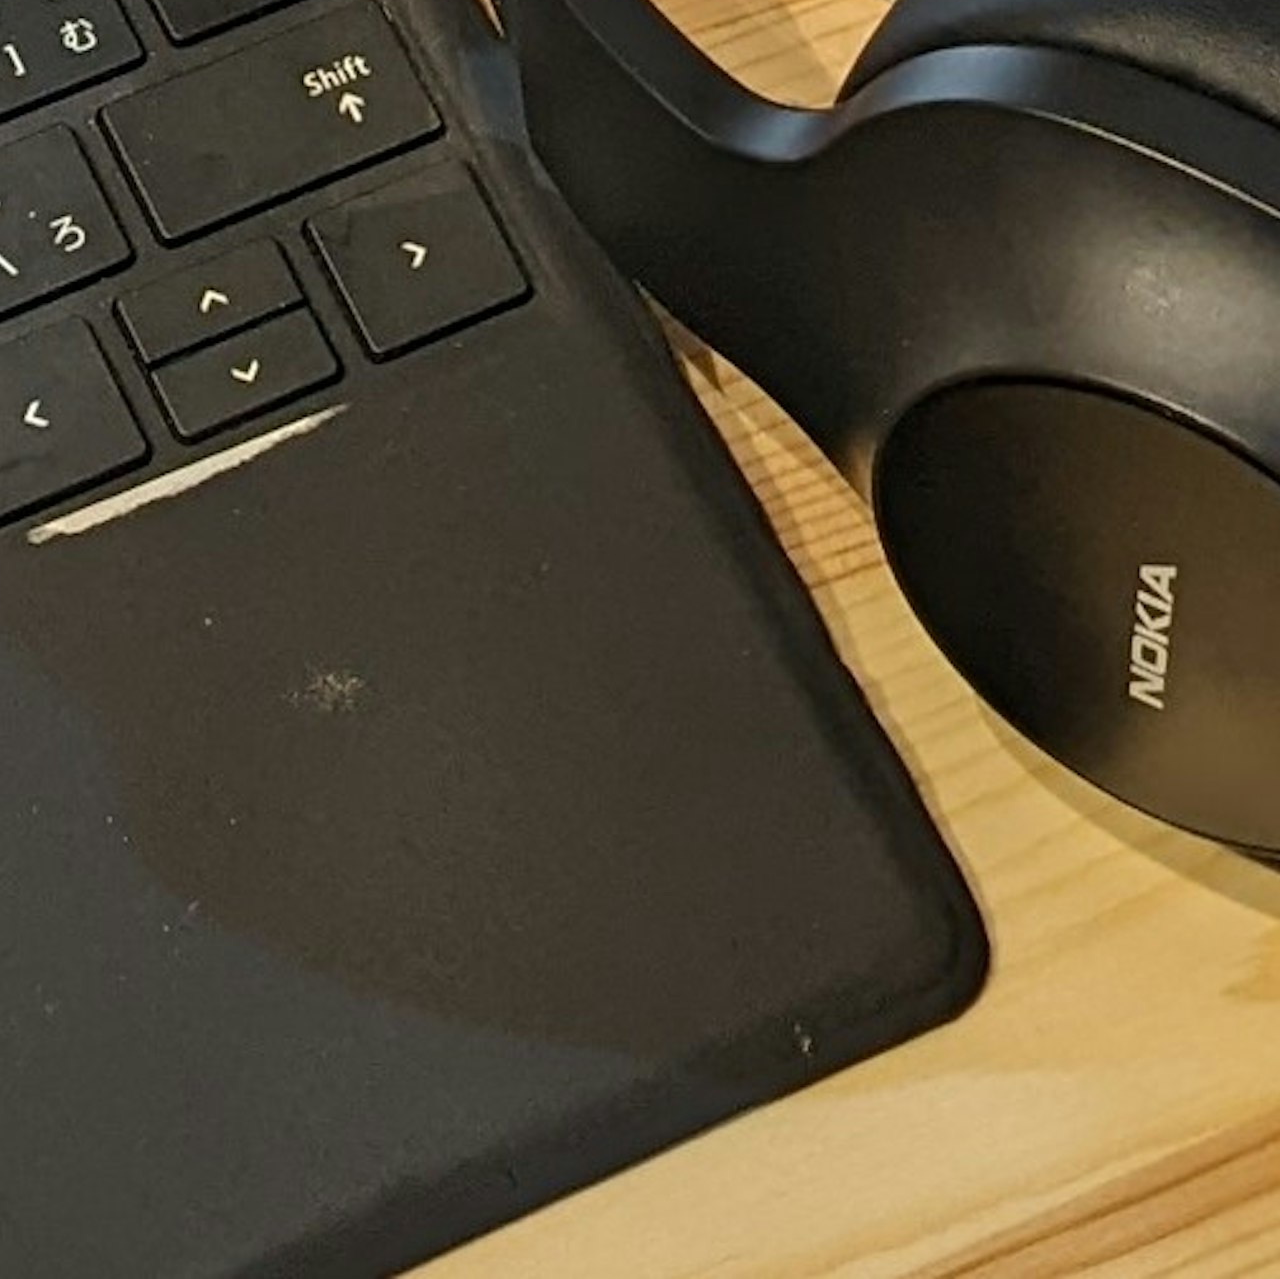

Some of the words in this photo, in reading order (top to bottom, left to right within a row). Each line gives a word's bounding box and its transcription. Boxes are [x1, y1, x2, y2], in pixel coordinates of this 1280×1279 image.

[60, 19, 98, 53] む
[303, 55, 371, 97] Shift
[50, 215, 87, 253] ろ
[1129, 562, 1177, 709] NOKIA
